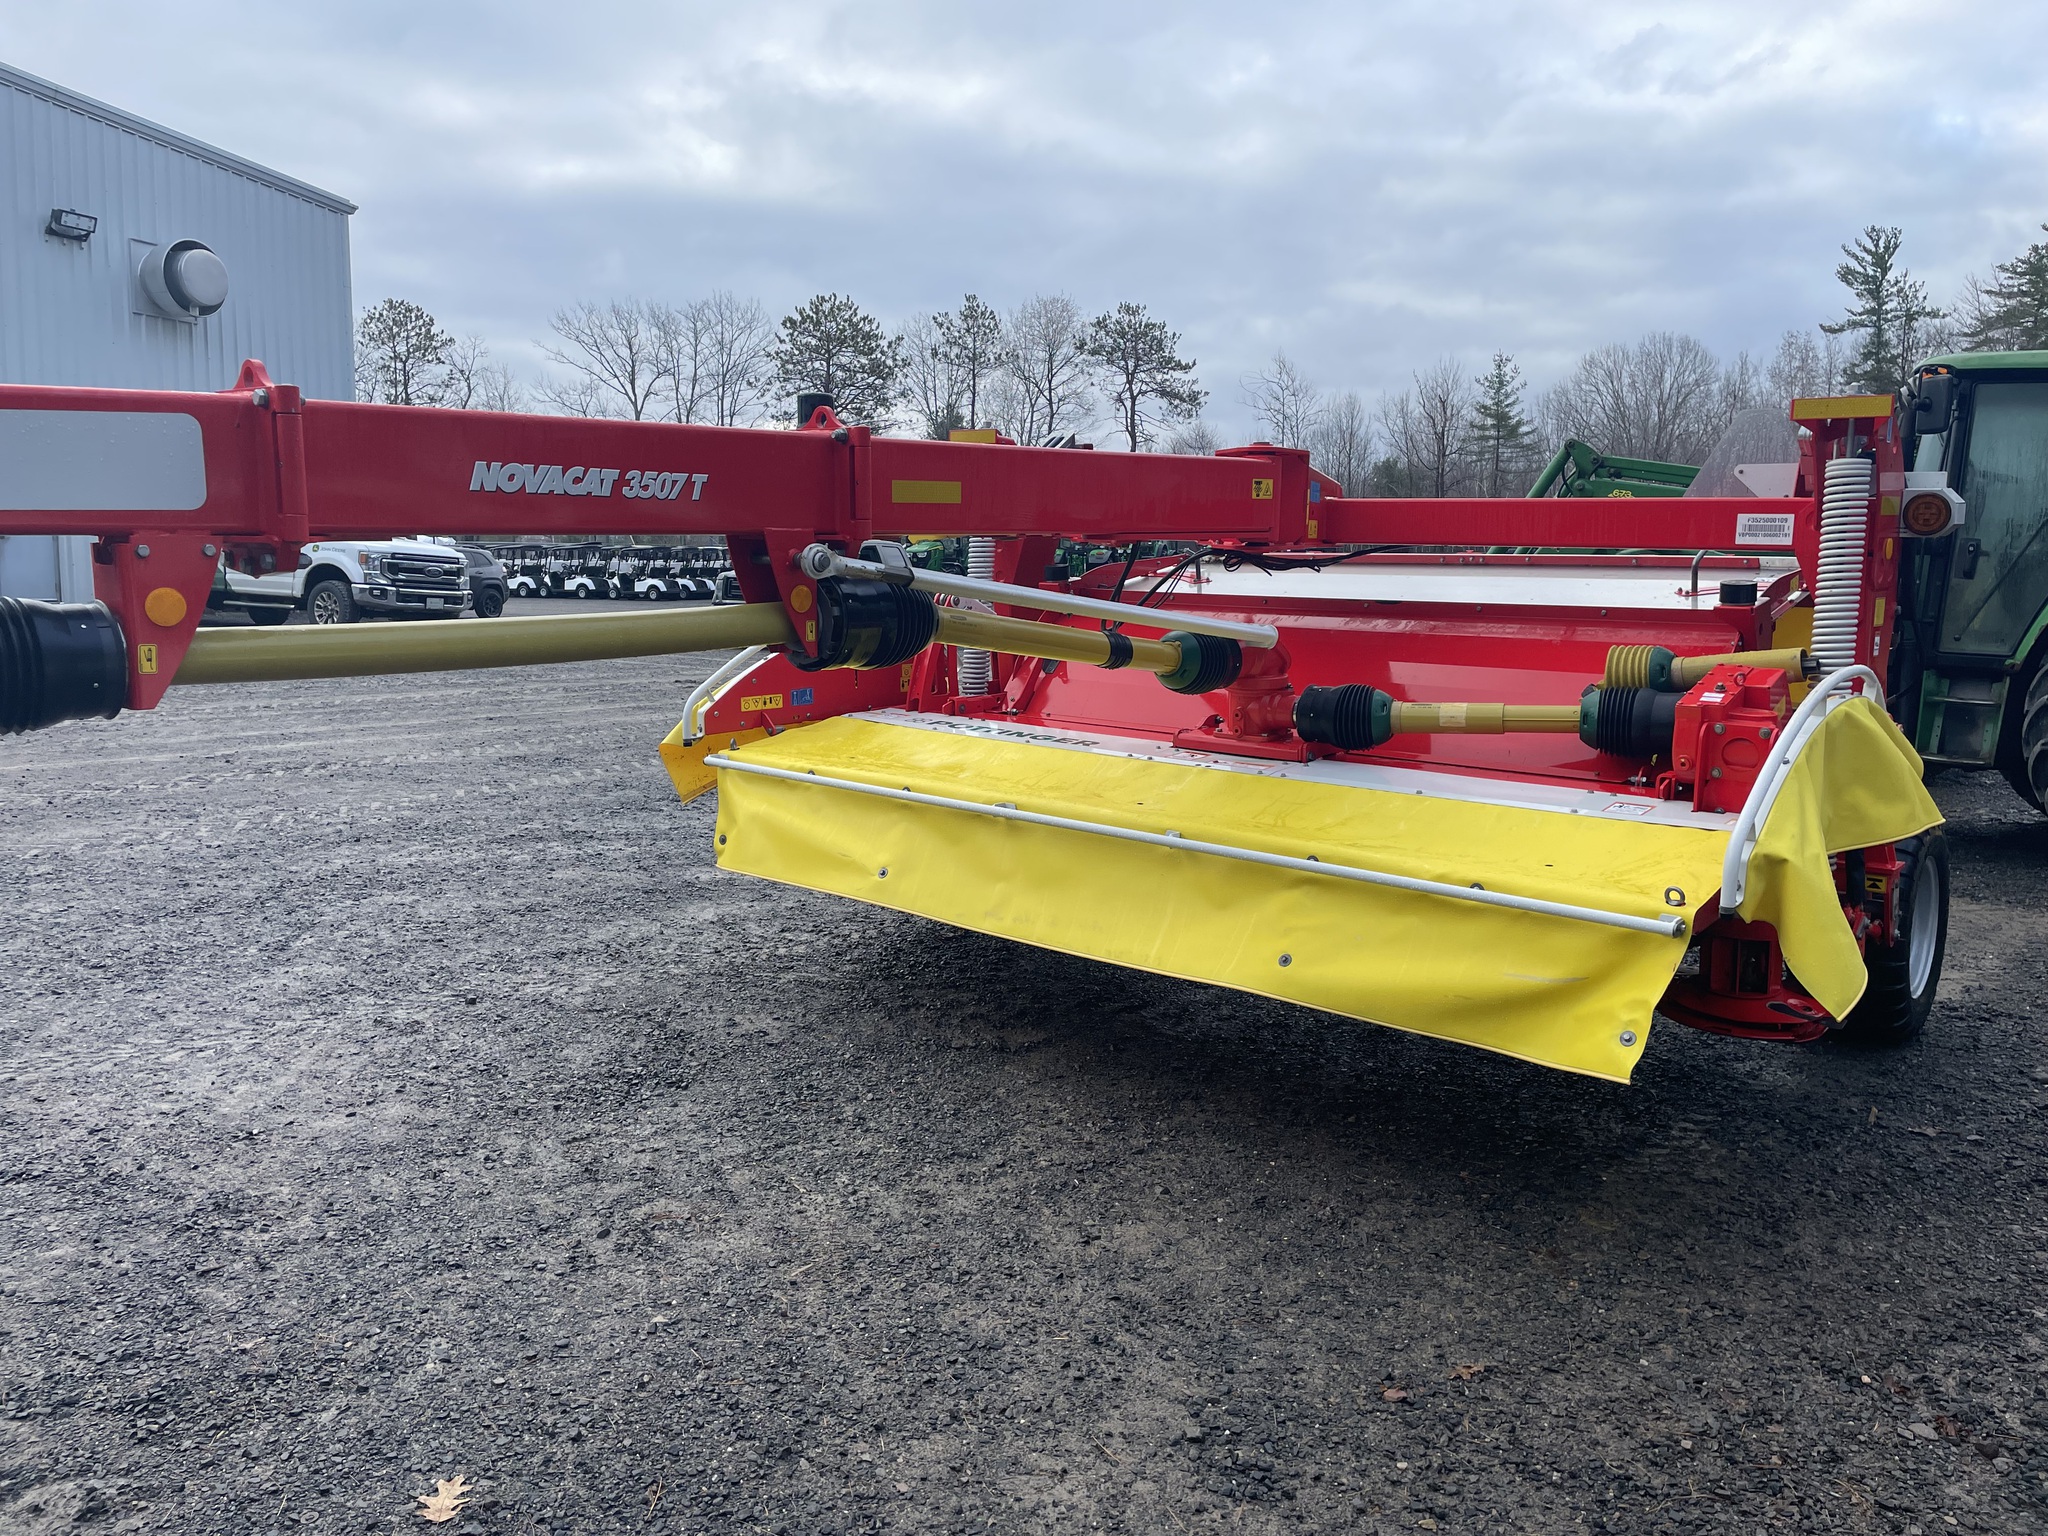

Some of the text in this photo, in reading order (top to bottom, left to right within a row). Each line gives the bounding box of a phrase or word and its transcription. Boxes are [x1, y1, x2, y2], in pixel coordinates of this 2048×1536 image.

[469, 460, 709, 500] NOVACAT 3507 T
[1612, 489, 1632, 498] 673
